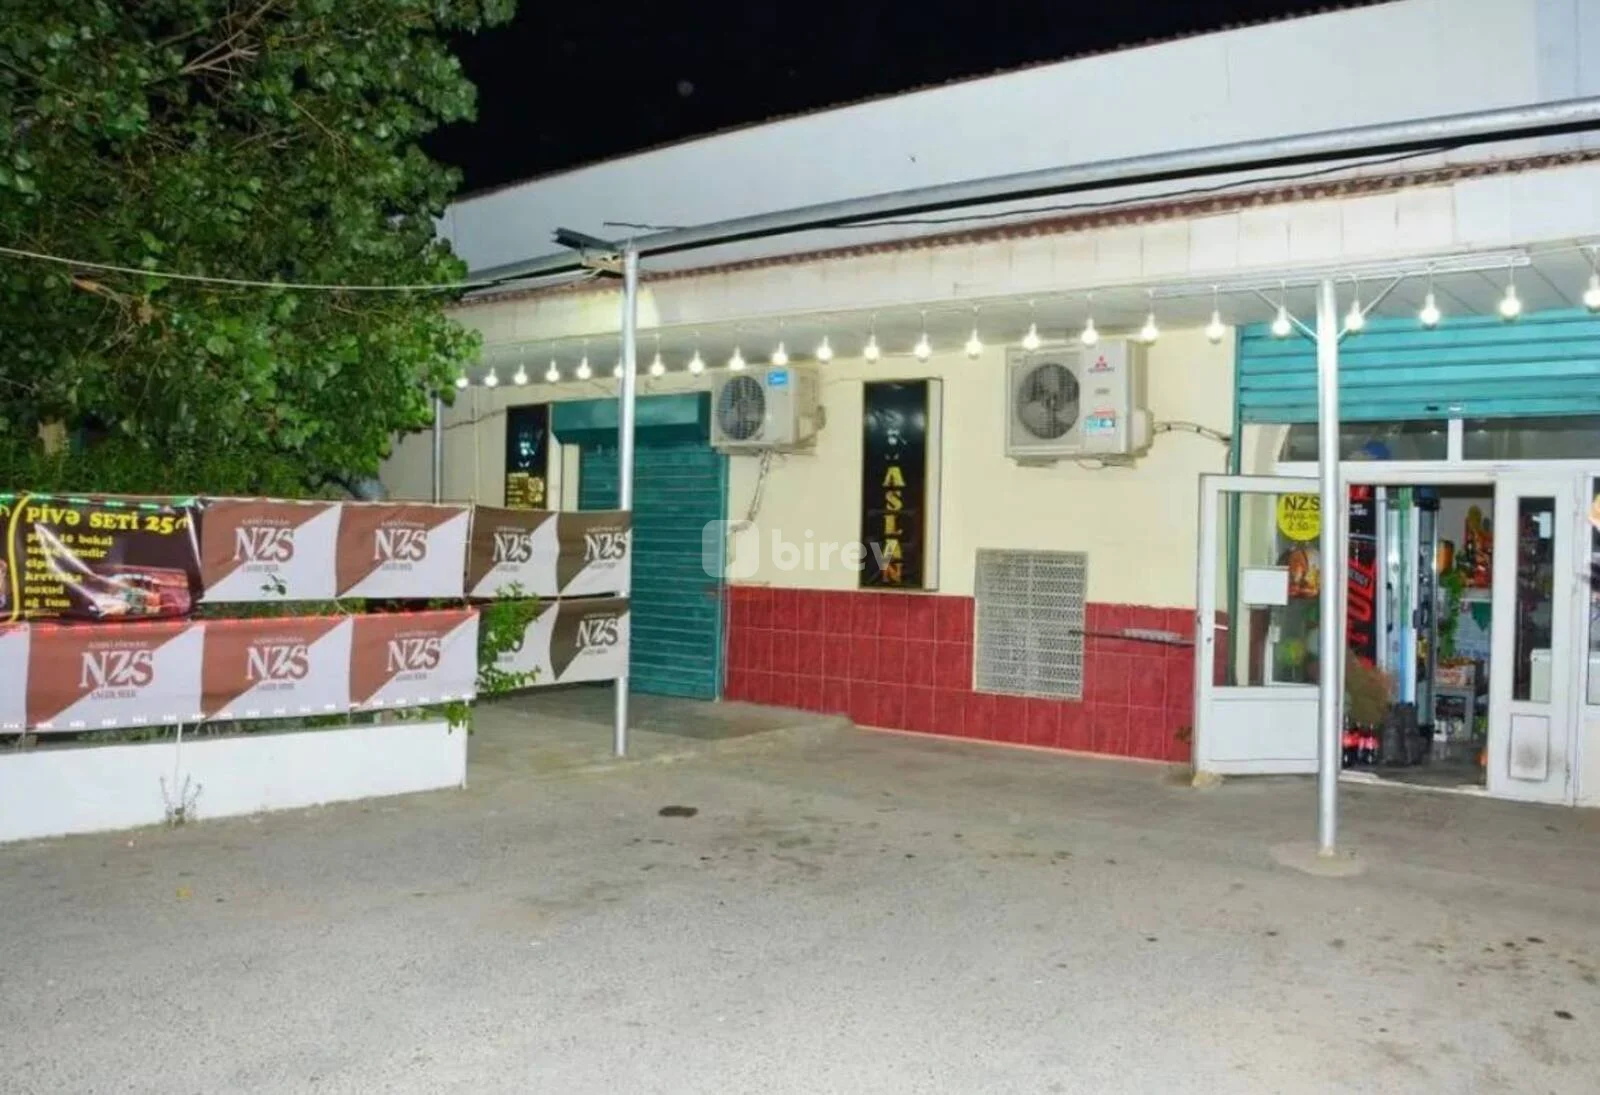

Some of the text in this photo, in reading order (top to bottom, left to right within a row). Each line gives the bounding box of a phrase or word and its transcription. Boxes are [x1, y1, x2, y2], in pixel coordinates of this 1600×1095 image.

[1284, 496, 1320, 511] NZS
[881, 466, 905, 582] ASLAN
[233, 527, 296, 563] NZS
[374, 528, 428, 562] NZS
[492, 532, 533, 563] NZS
[583, 532, 627, 561] NZS
[575, 618, 619, 648] NZS
[78, 649, 154, 688] NZS
[245, 644, 309, 680] NZS
[385, 637, 441, 672] NZS
